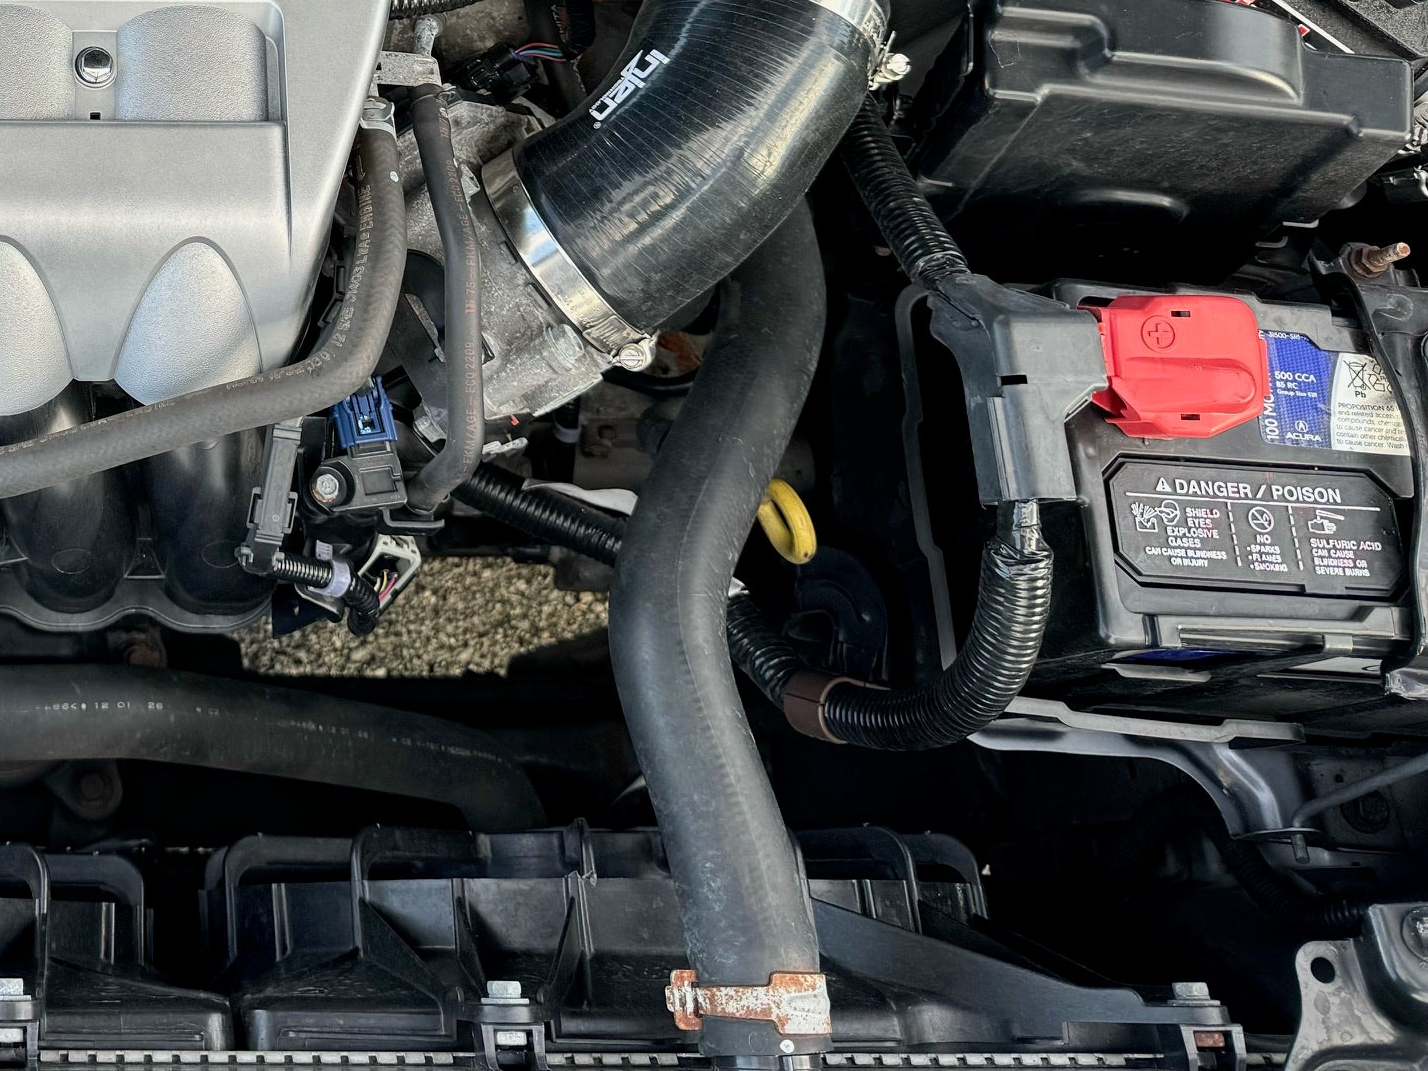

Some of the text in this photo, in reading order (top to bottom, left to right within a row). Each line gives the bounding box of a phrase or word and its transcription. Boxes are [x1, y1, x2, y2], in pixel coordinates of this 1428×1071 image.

[1274, 370, 1317, 383] 500 CCA
[1287, 382, 1299, 390] RC
[1354, 391, 1367, 399] Pb
[1337, 402, 1385, 412] PROPOSITION
[1266, 418, 1280, 440] 100
[1285, 433, 1322, 442] ACURA
[1174, 478, 1342, 504] DANGER / POISON
[1185, 507, 1220, 518] SHIELD
[1186, 517, 1213, 528] EYES
[1166, 526, 1220, 539] EXPLOSIVE
[1168, 536, 1202, 548] GASES
[1256, 534, 1272, 544] NO
[1309, 538, 1383, 551] SULFURIC ACID
[1145, 546, 1227, 560] CAN CAUSE BLINDNESS
[1250, 544, 1281, 554] SPARKS
[1312, 548, 1355, 559] CAN CAUSE
[1170, 557, 1209, 567] OR INJURY
[1252, 553, 1283, 563] FLAMES
[1313, 557, 1368, 569] BLINDNESS OR
[1253, 562, 1289, 572] SMOKING
[1315, 566, 1371, 577] SEVERE BURNS
